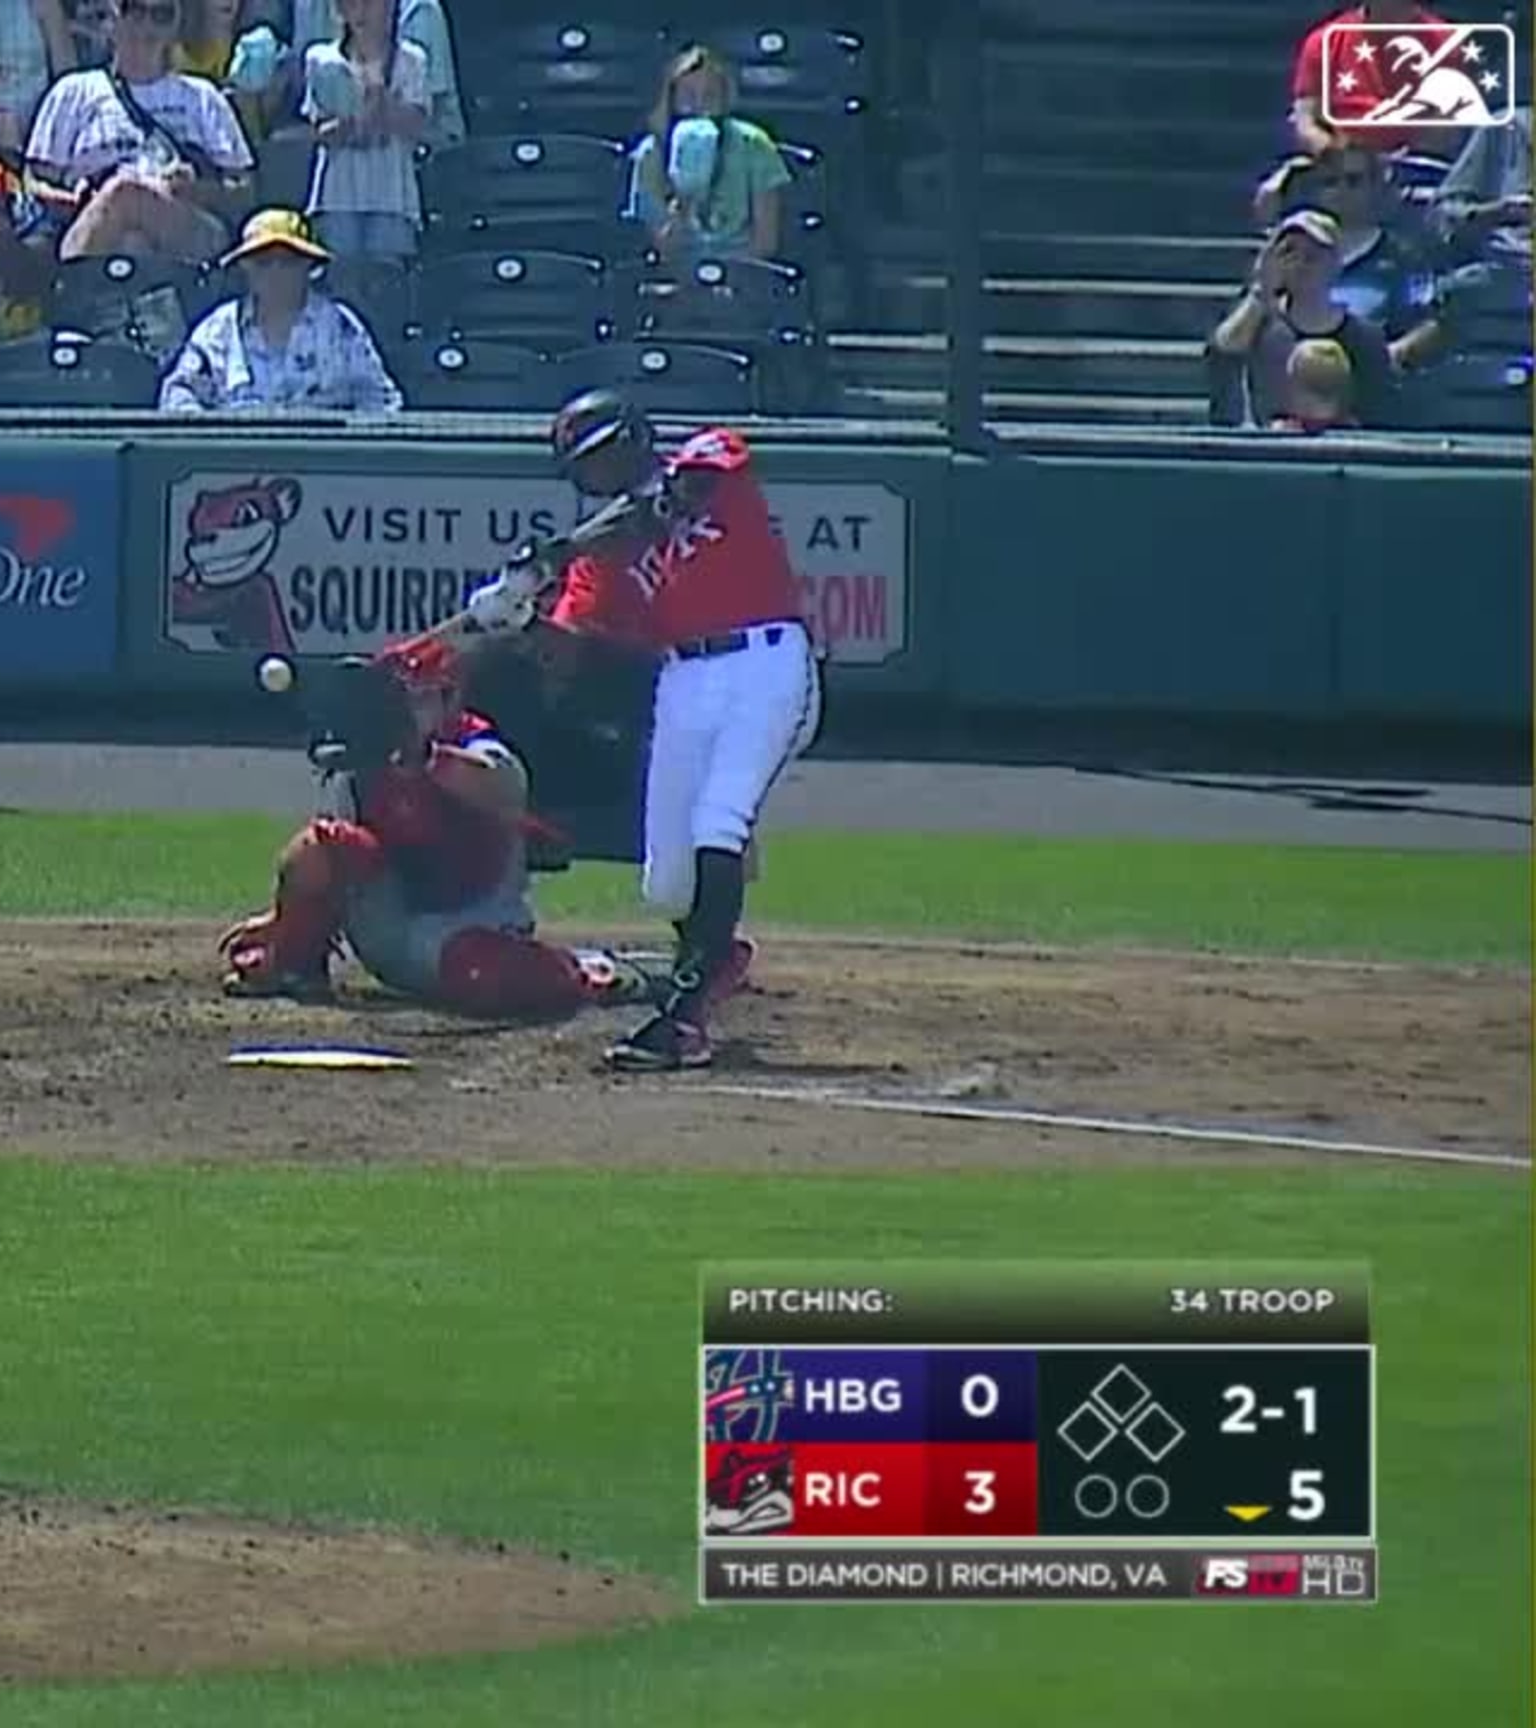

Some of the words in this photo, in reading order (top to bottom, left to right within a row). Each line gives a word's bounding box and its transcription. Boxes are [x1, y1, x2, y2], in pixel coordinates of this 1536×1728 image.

[323, 506, 462, 542] VISIT
[489, 509, 557, 544] US
[807, 516, 871, 550] AT
